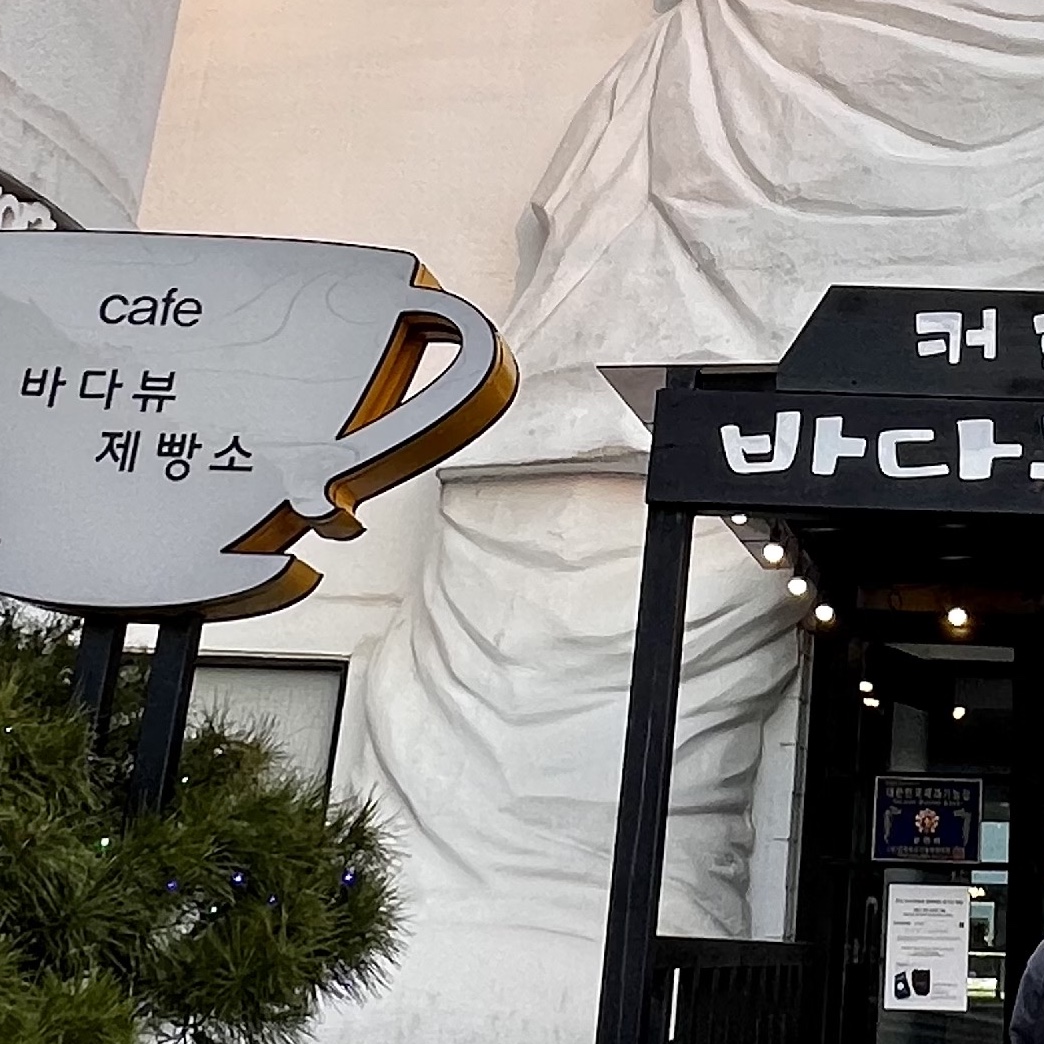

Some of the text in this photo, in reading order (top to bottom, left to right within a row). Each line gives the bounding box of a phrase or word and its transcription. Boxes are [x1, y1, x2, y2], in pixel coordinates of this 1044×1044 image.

[100, 288, 203, 328] cafe
[21, 366, 177, 413] 바다뷰
[95, 430, 254, 482] 제빵소
